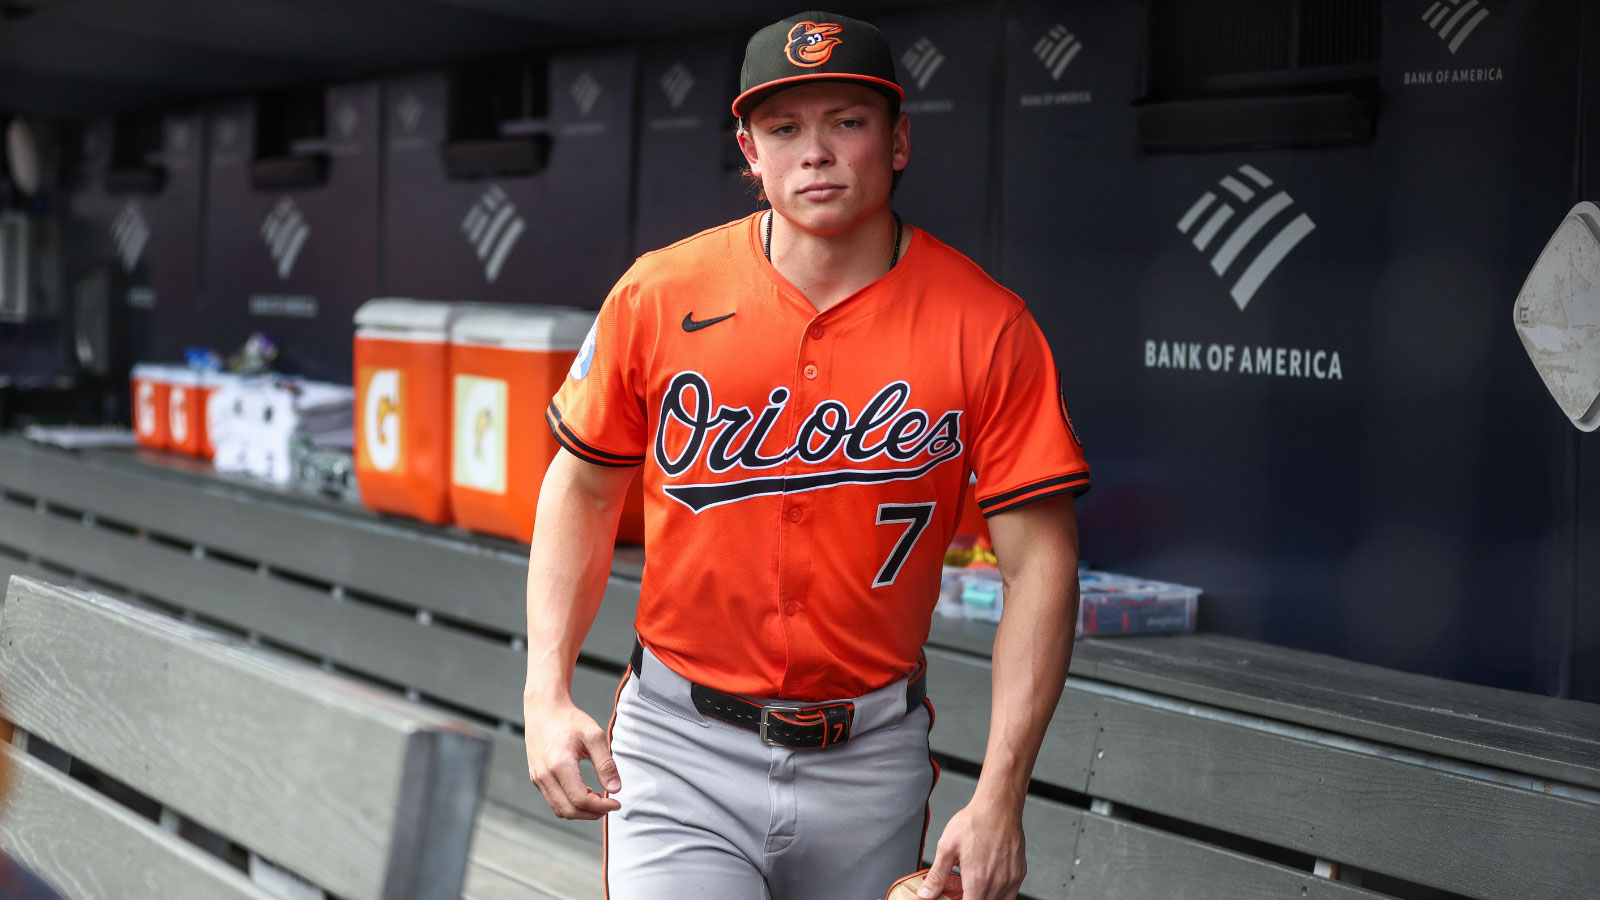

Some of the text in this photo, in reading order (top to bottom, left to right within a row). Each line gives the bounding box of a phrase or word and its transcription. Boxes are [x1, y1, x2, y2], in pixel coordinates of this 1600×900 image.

[1404, 67, 1503, 85] BANK OF AMERICA
[1144, 339, 1343, 380] BANK OF AMERICA
[364, 369, 400, 472] G
[463, 381, 499, 487] G
[654, 370, 964, 478] Orioles
[871, 501, 937, 589] 7
[832, 723, 844, 743] 7
